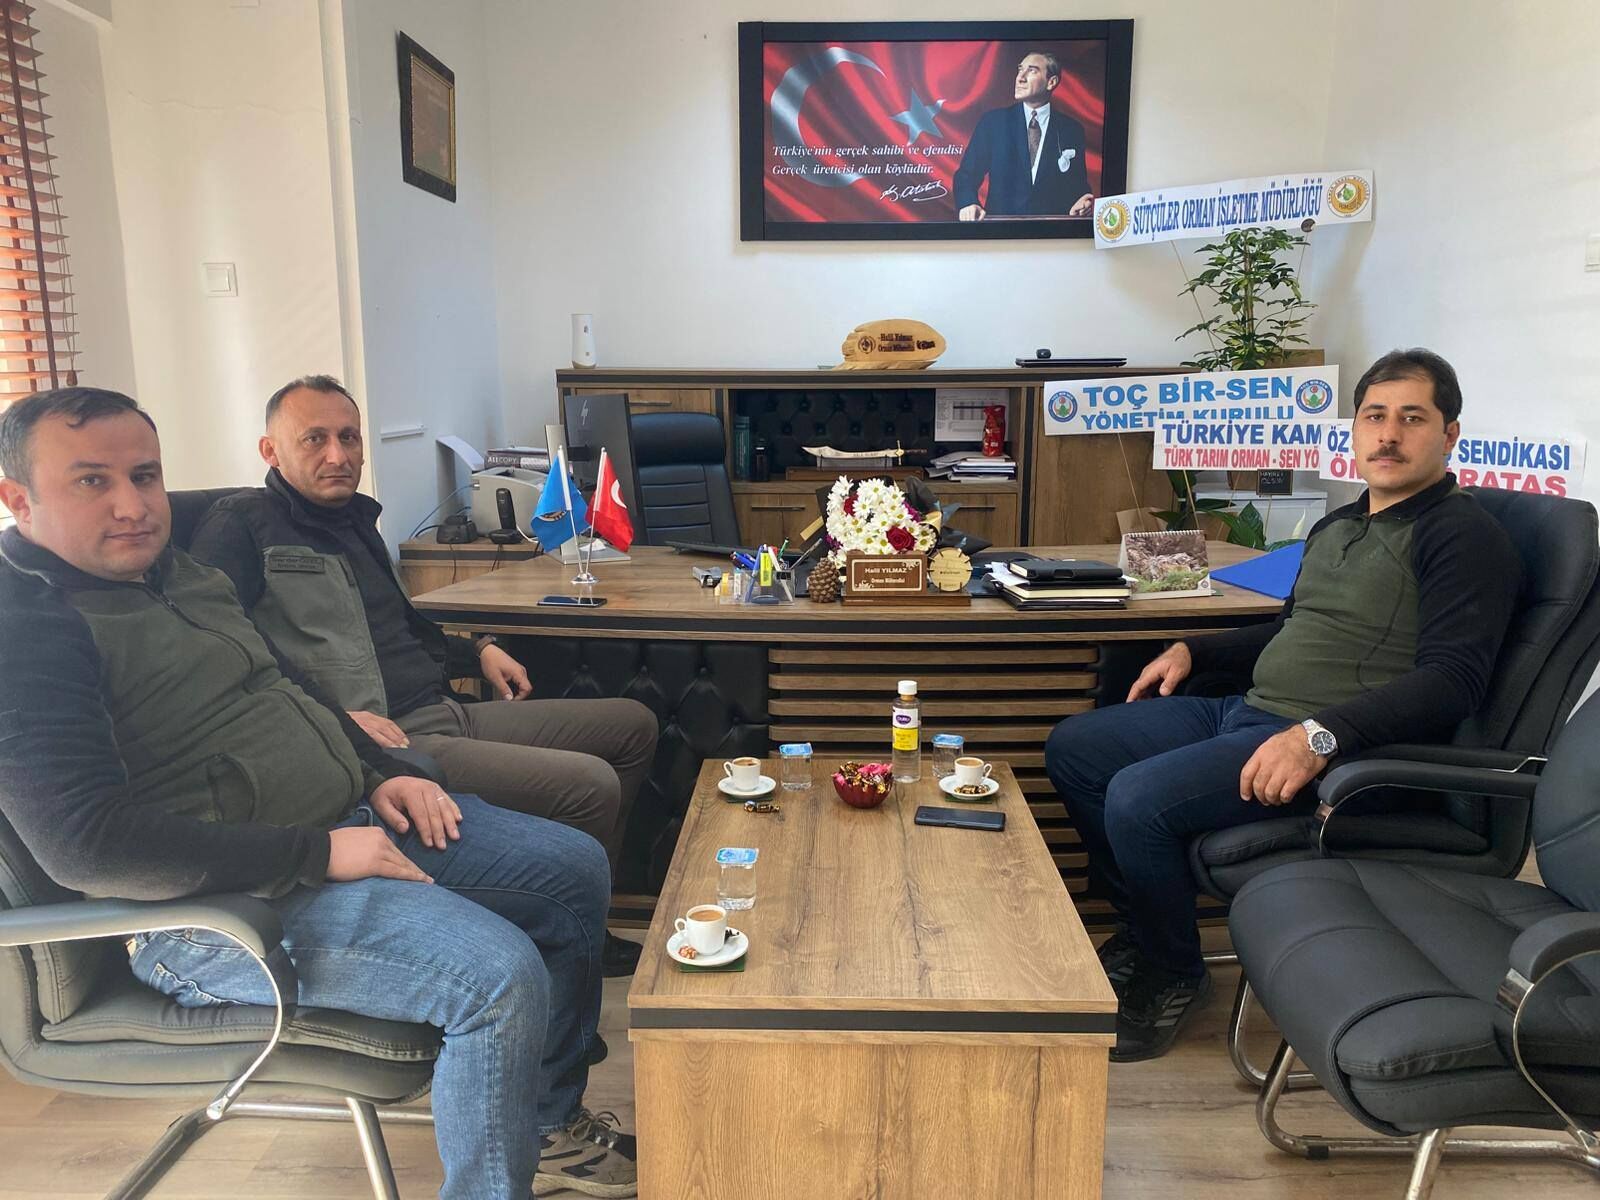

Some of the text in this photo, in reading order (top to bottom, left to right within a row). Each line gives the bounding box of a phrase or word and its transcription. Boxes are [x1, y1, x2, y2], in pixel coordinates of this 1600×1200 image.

[772, 145, 963, 159] Türkiye'nin gerçek sahibi ve efendisi
[772, 164, 934, 177] Gerçek üreticisi olan köylüdür.
[1132, 194, 1180, 241] SÜTÇÜLER
[1181, 198, 1216, 229] ORMAN
[1217, 187, 1259, 235] İŞLETME
[1260, 178, 1323, 220] MÜDÜRLÜĞÜ
[1083, 384, 1148, 410] TOÇ
[1158, 375, 1293, 404] BİR-SEN
[1162, 419, 1265, 445] TÜRKİYE
[1164, 444, 1194, 468] TÜRK
[1195, 449, 1229, 468] TARIM
[1231, 448, 1270, 469] ORMAN
[1279, 448, 1302, 468] SEN
[1304, 445, 1320, 468] YÖ
[1327, 425, 1350, 453] ÖZ
[1458, 436, 1570, 471] SENDİKASI
